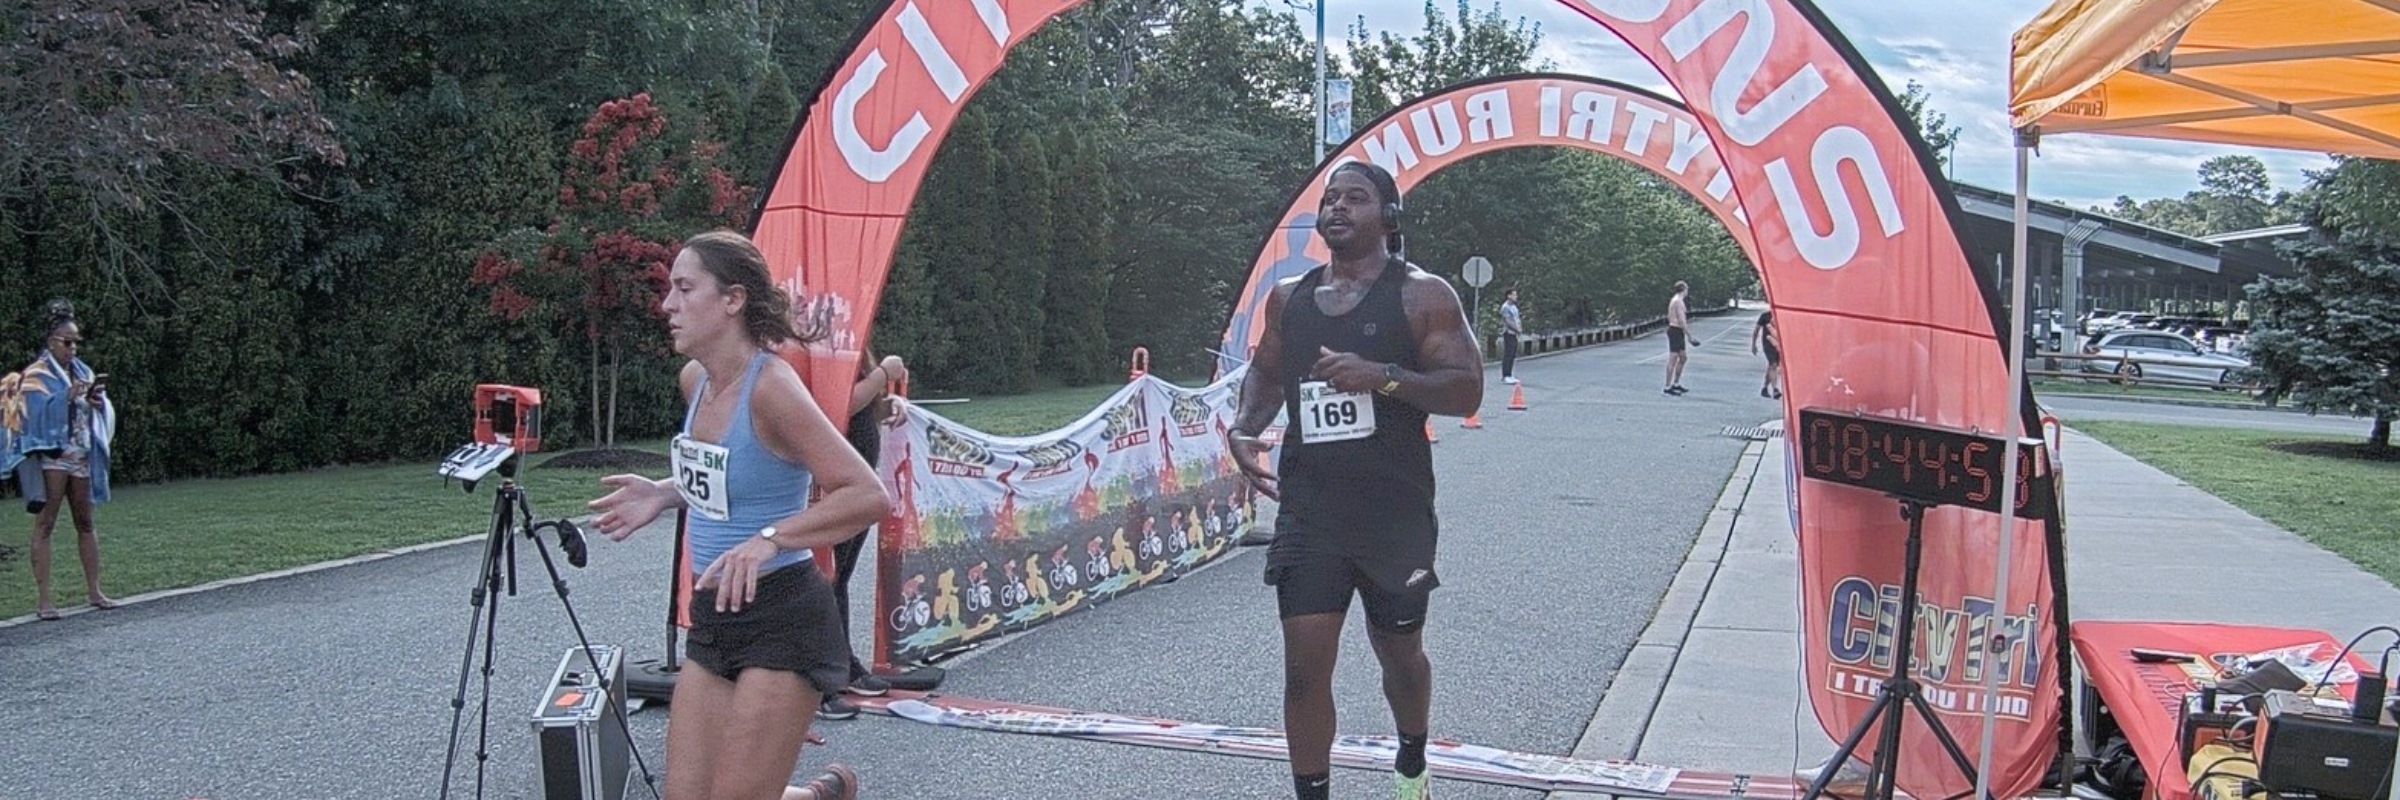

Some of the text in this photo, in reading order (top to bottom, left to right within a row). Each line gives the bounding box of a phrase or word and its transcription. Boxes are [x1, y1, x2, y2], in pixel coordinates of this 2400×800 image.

[1585, 0, 1905, 271] NS
[1301, 387, 1315, 402] 5K
[1310, 400, 1358, 429] 169
[703, 450, 726, 472] 5K
[1834, 671, 1845, 690] I
[1852, 674, 1883, 697] TR
[1921, 684, 1957, 710] OU
[1966, 691, 1976, 712] I
